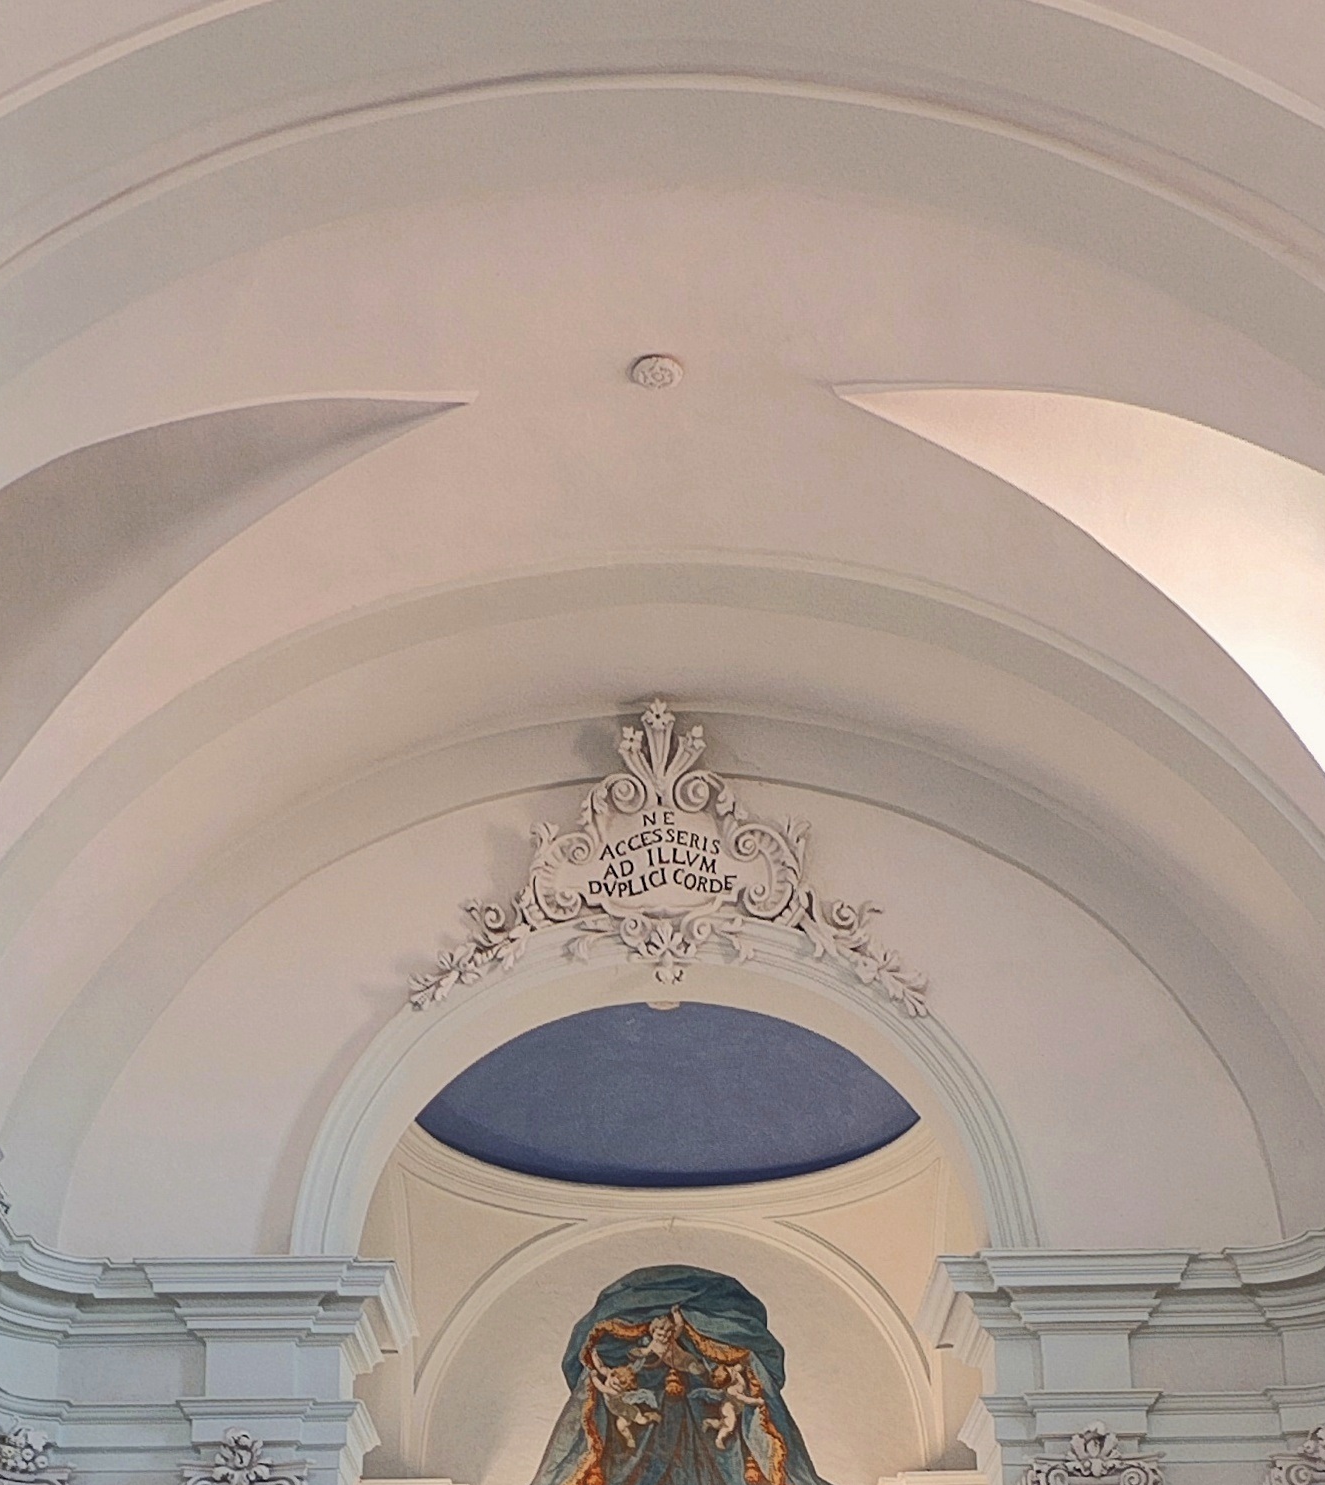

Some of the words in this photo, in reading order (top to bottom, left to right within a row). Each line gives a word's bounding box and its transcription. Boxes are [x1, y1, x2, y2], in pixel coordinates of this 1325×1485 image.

[642, 811, 675, 827] NE
[599, 828, 721, 861] ACCESSERIS
[603, 859, 634, 880] AD
[646, 847, 717, 875] ILLVM
[588, 867, 668, 898] DVPLICI
[672, 868, 737, 894] CORDE
